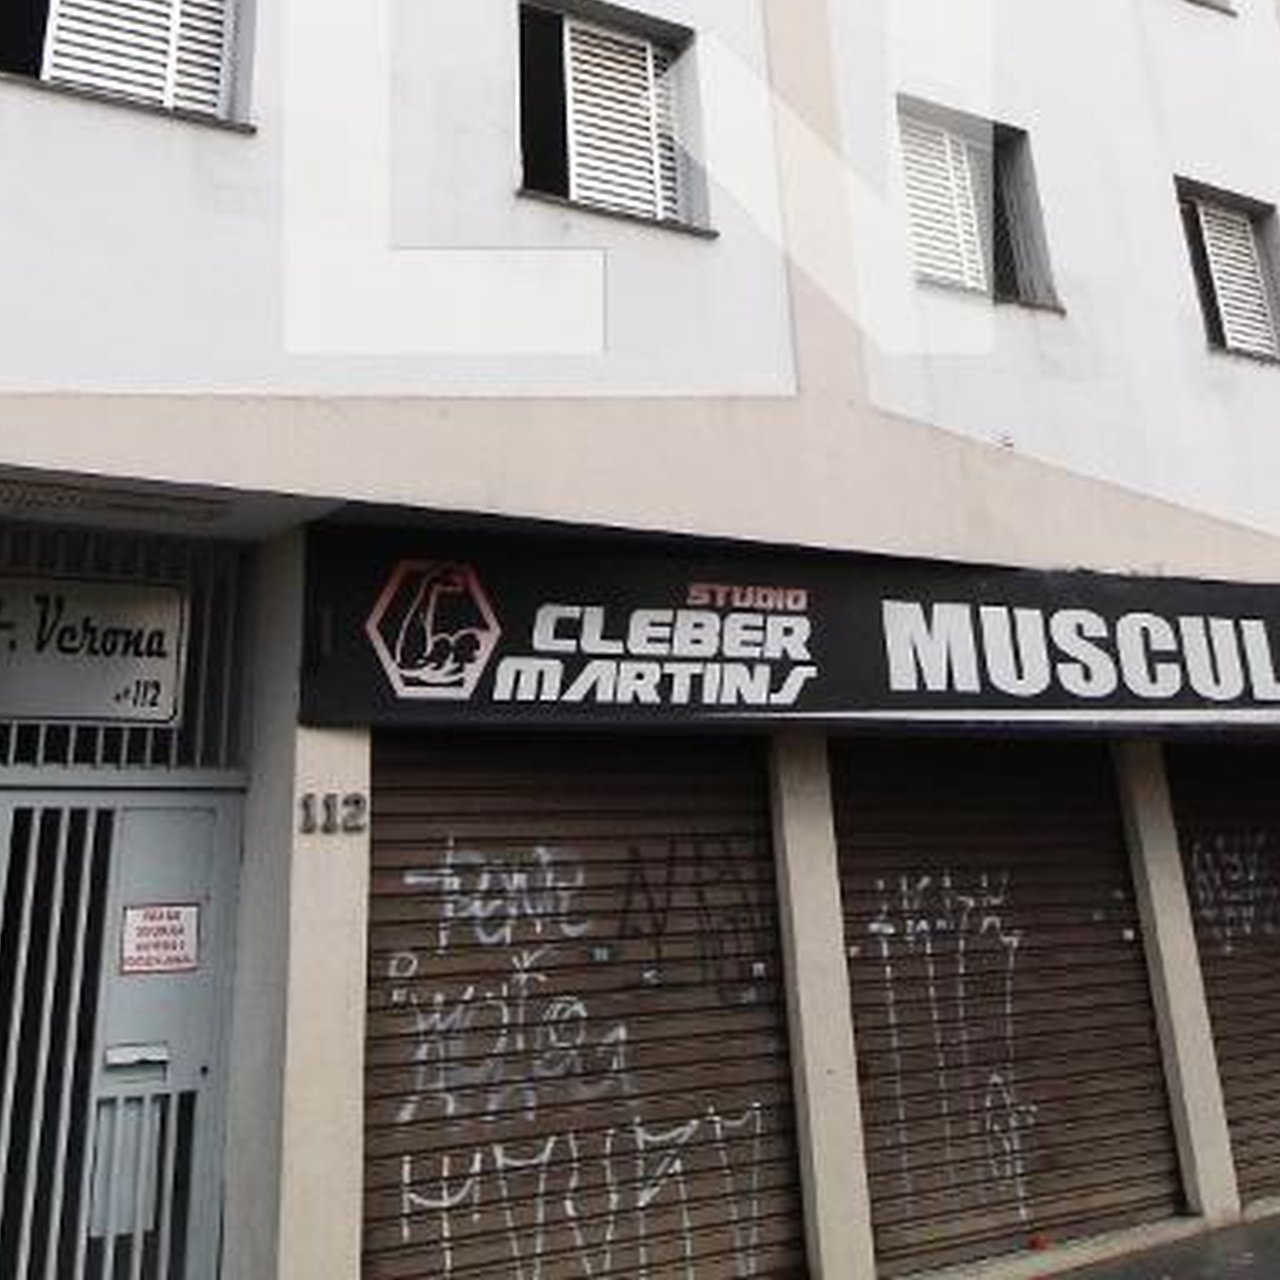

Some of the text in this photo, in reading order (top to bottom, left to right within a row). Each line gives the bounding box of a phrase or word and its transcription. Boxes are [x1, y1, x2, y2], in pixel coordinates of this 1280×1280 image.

[687, 582, 809, 611] STUDIO
[35, 595, 168, 658] Verona
[532, 603, 812, 660] CLEBER
[492, 656, 818, 705] MARTINS
[300, 793, 367, 835] 112
